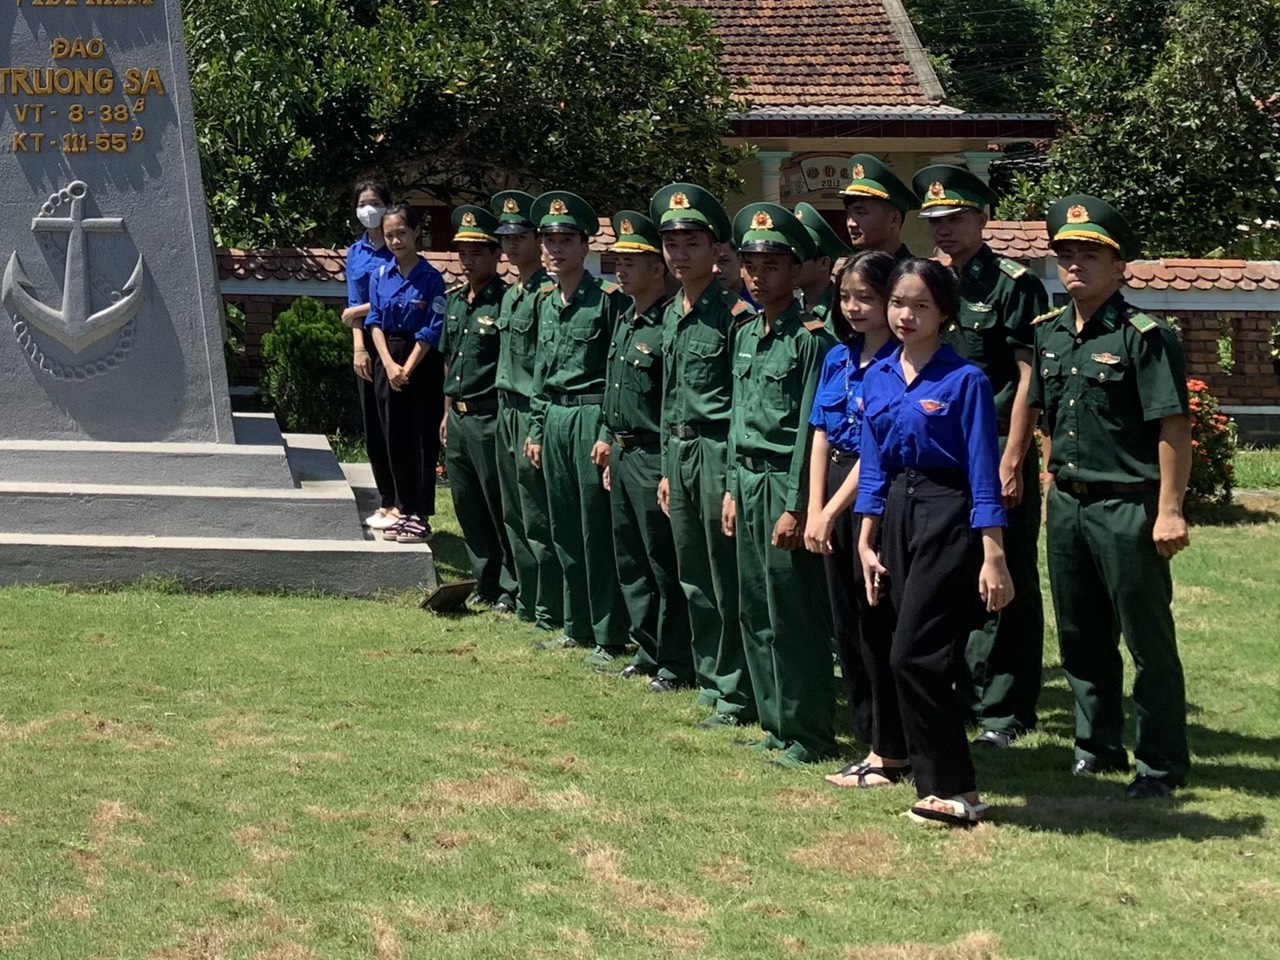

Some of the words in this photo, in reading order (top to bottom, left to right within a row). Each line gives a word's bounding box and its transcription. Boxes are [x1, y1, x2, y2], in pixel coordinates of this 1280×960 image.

[123, 67, 165, 96] SA
[14, 103, 45, 124] VT
[12, 132, 45, 153] KT
